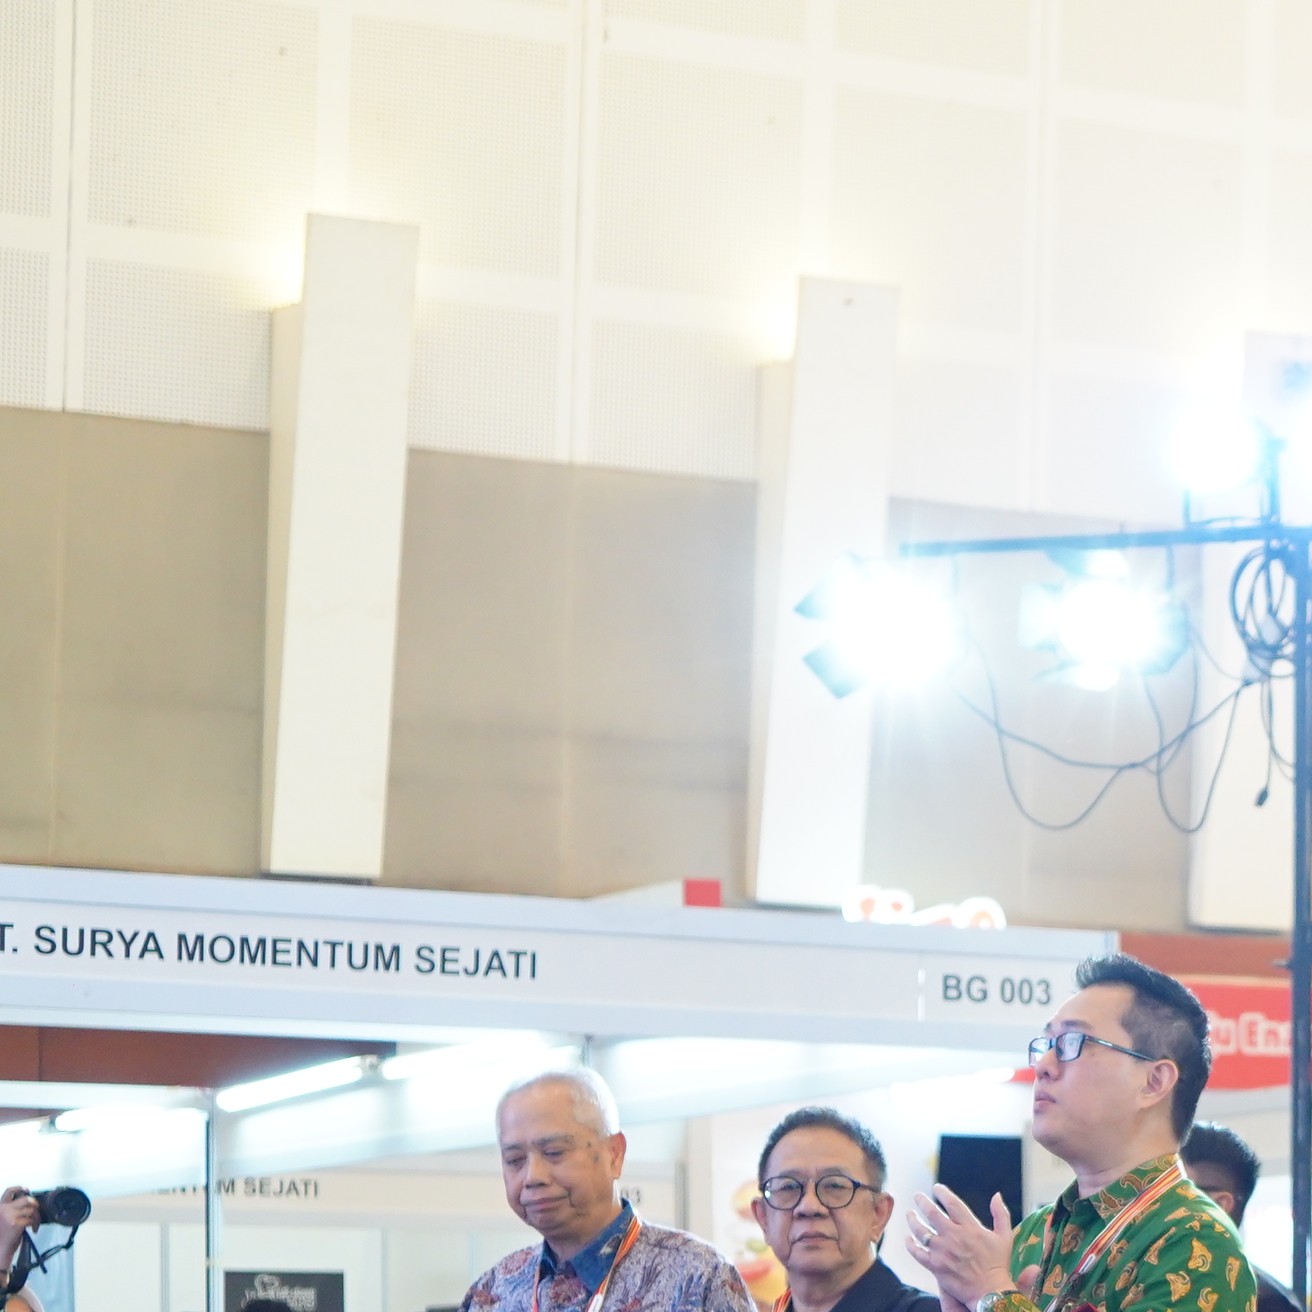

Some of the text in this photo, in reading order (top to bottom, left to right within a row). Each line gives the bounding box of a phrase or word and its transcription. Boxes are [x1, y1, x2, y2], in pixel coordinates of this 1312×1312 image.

[34, 925, 164, 961] SURYA
[176, 933, 401, 972] MOMENTUM
[414, 945, 537, 980] SEJATI
[942, 975, 1051, 1005] BG 003
[244, 1177, 320, 1198] SEJATI
